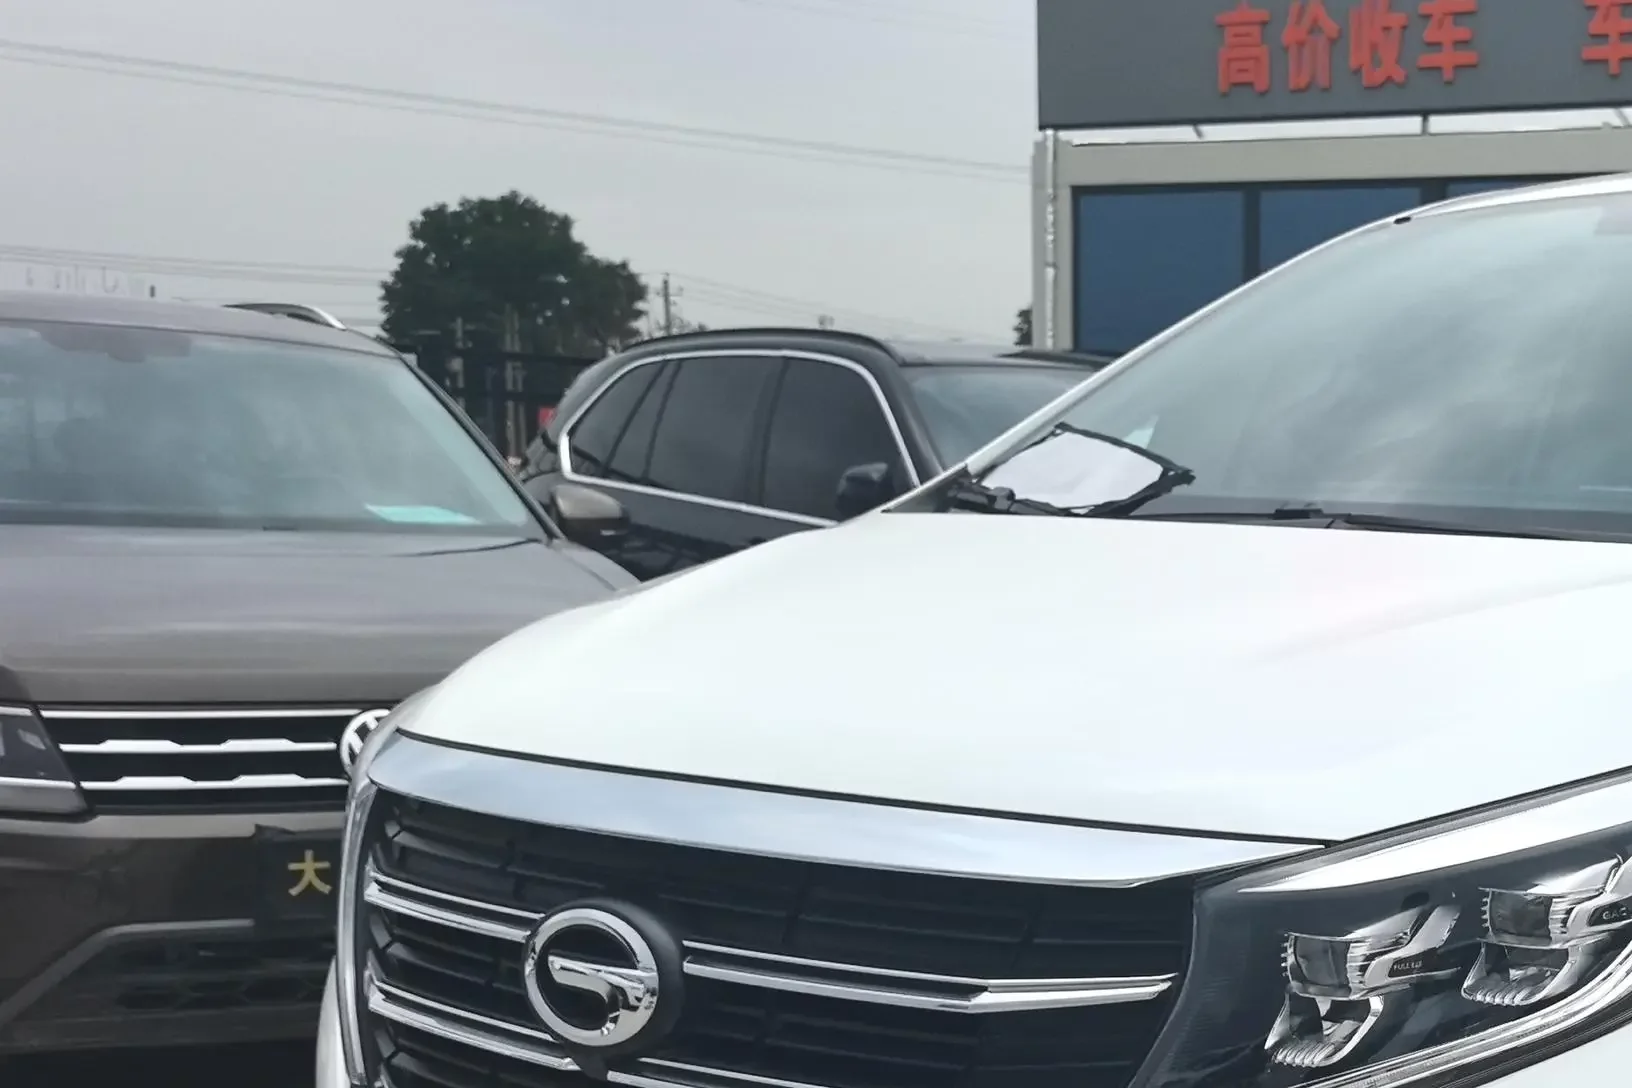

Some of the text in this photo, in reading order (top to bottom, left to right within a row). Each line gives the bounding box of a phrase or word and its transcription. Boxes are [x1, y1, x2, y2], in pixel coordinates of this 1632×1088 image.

[1215, 0, 1479, 94] 高价收车
[287, 848, 332, 896] 大
